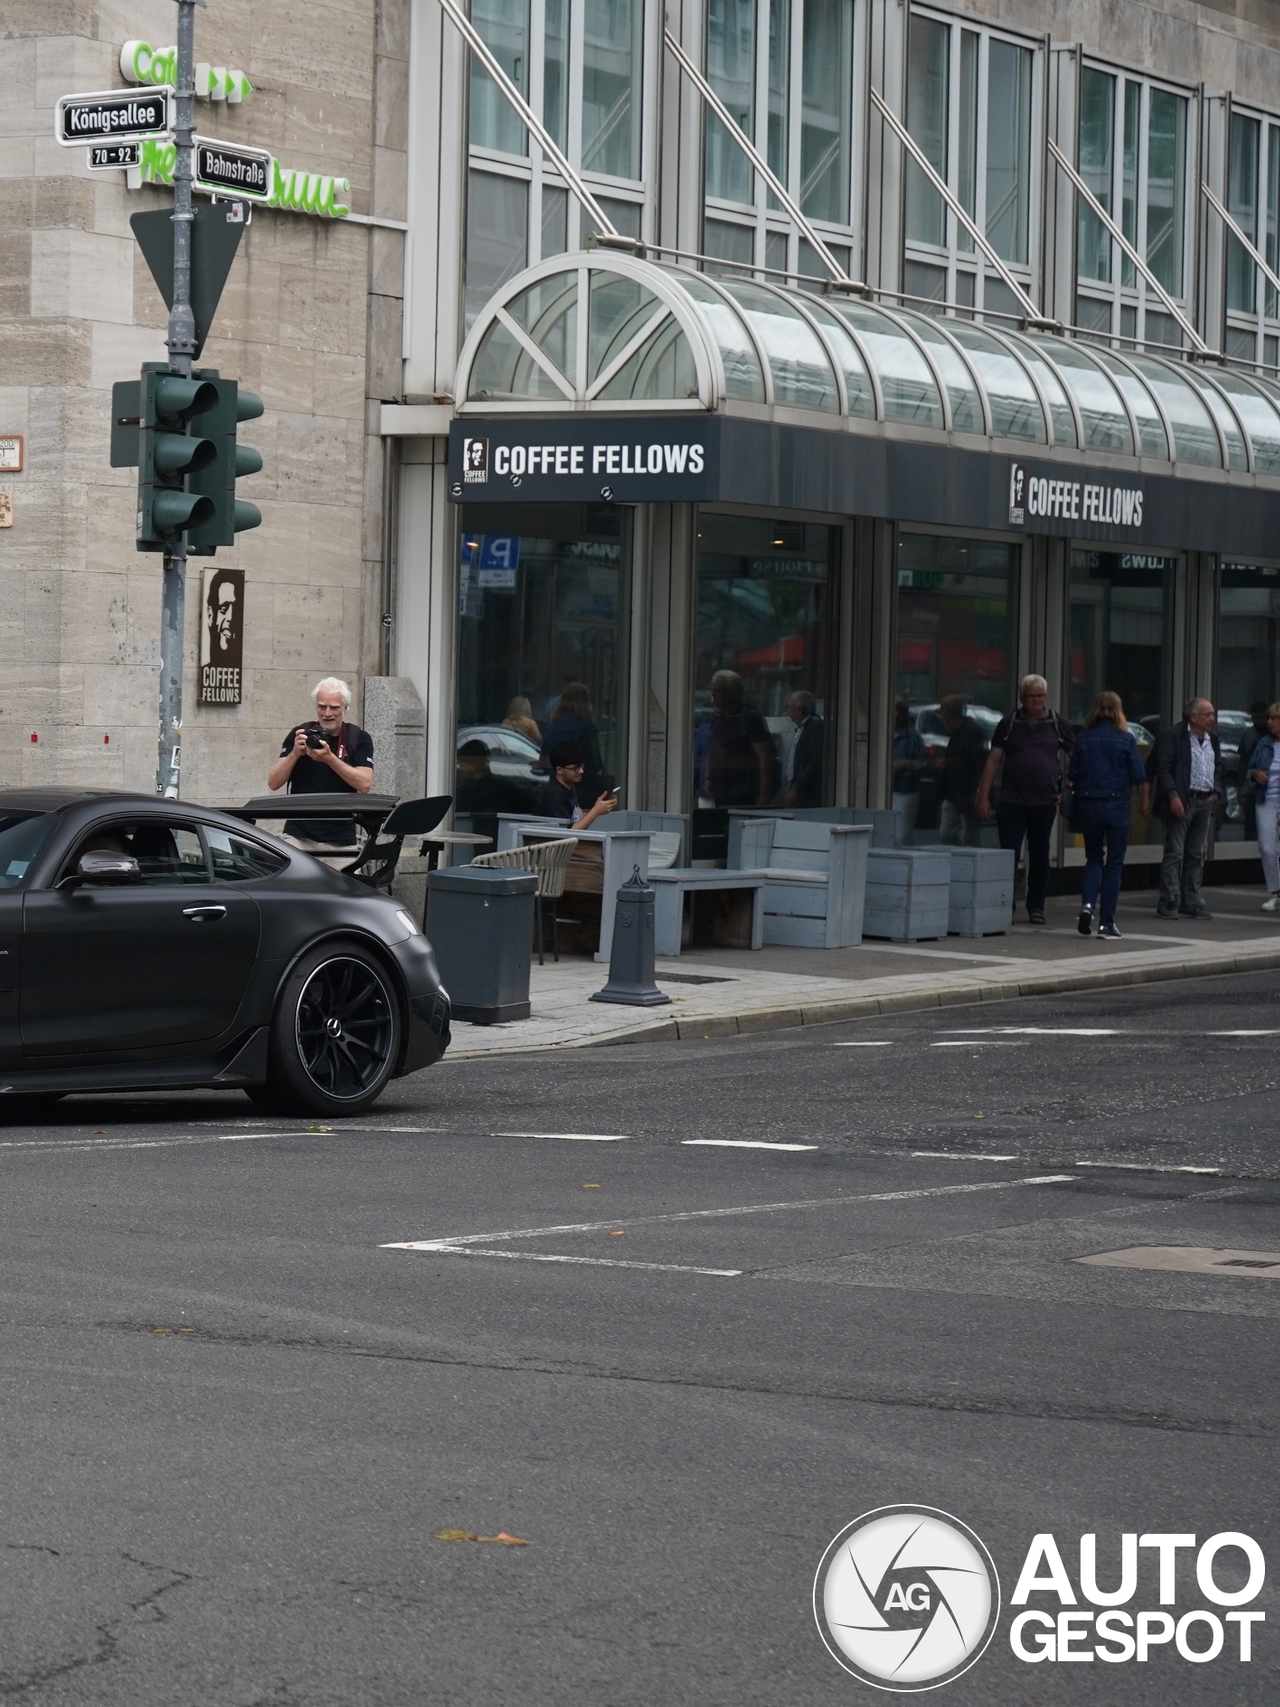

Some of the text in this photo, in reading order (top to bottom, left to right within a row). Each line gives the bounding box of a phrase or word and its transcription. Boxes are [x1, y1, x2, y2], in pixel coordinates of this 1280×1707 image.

[131, 41, 177, 88] Caf
[70, 103, 155, 132] Königsallee
[95, 149, 107, 164] 70
[118, 147, 131, 162] 92
[206, 151, 264, 185] Bahnstraße
[464, 470, 486, 478] COFFEE
[495, 444, 704, 475] COFFEE FELLOWS
[1028, 476, 1143, 527] COFFEE FELLOWS
[203, 666, 240, 687] COFFEE
[202, 688, 240, 702] FELLOWS
